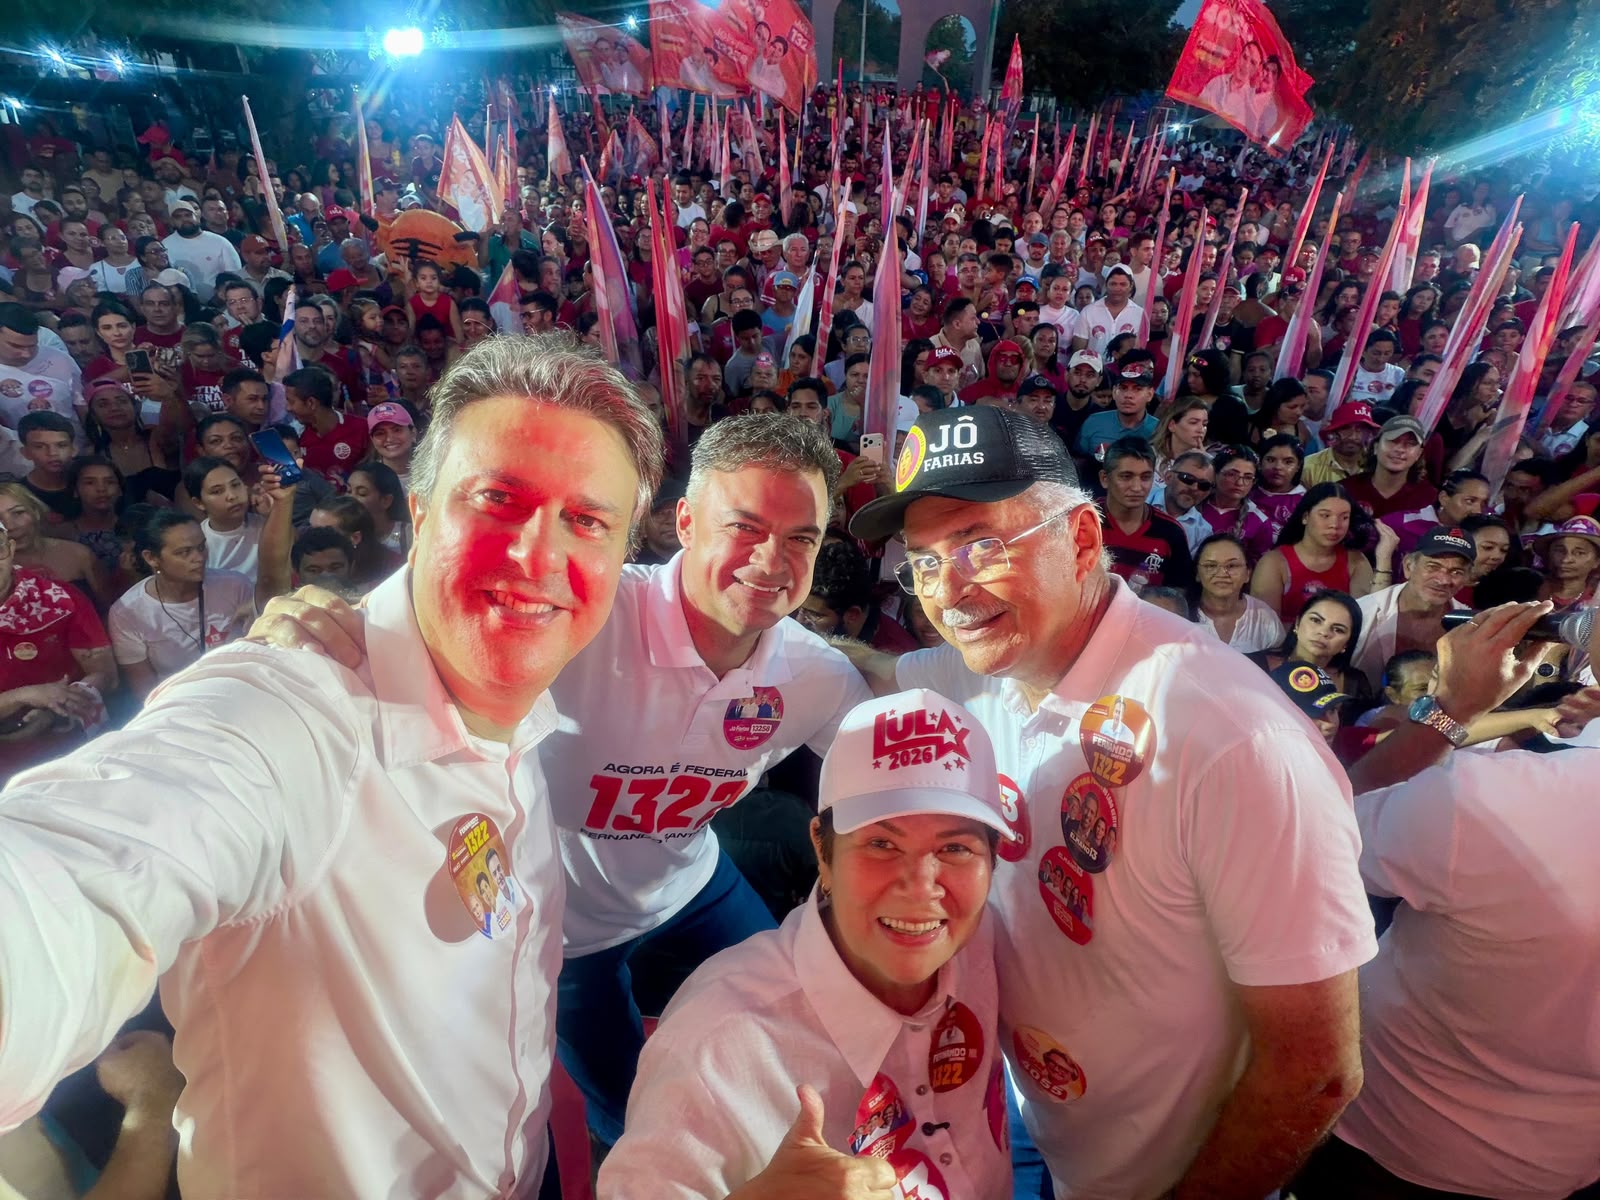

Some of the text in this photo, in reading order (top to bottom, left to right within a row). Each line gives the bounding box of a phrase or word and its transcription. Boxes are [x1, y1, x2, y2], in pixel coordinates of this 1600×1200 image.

[929, 415, 978, 453] JÔ
[923, 452, 984, 473] FARIAS
[1433, 535, 1472, 549] CONCEITO
[873, 709, 971, 762] LULA
[1092, 735, 1134, 759] FERNANDO
[603, 762, 749, 777] AGORA É FEDERAL
[888, 747, 933, 770] 2026
[1091, 751, 1127, 785] 1322
[459, 815, 479, 837] FERNANDO
[464, 820, 490, 856] 1322
[1069, 831, 1098, 861] ELMANO 13
[933, 1047, 966, 1064] FERNANDO
